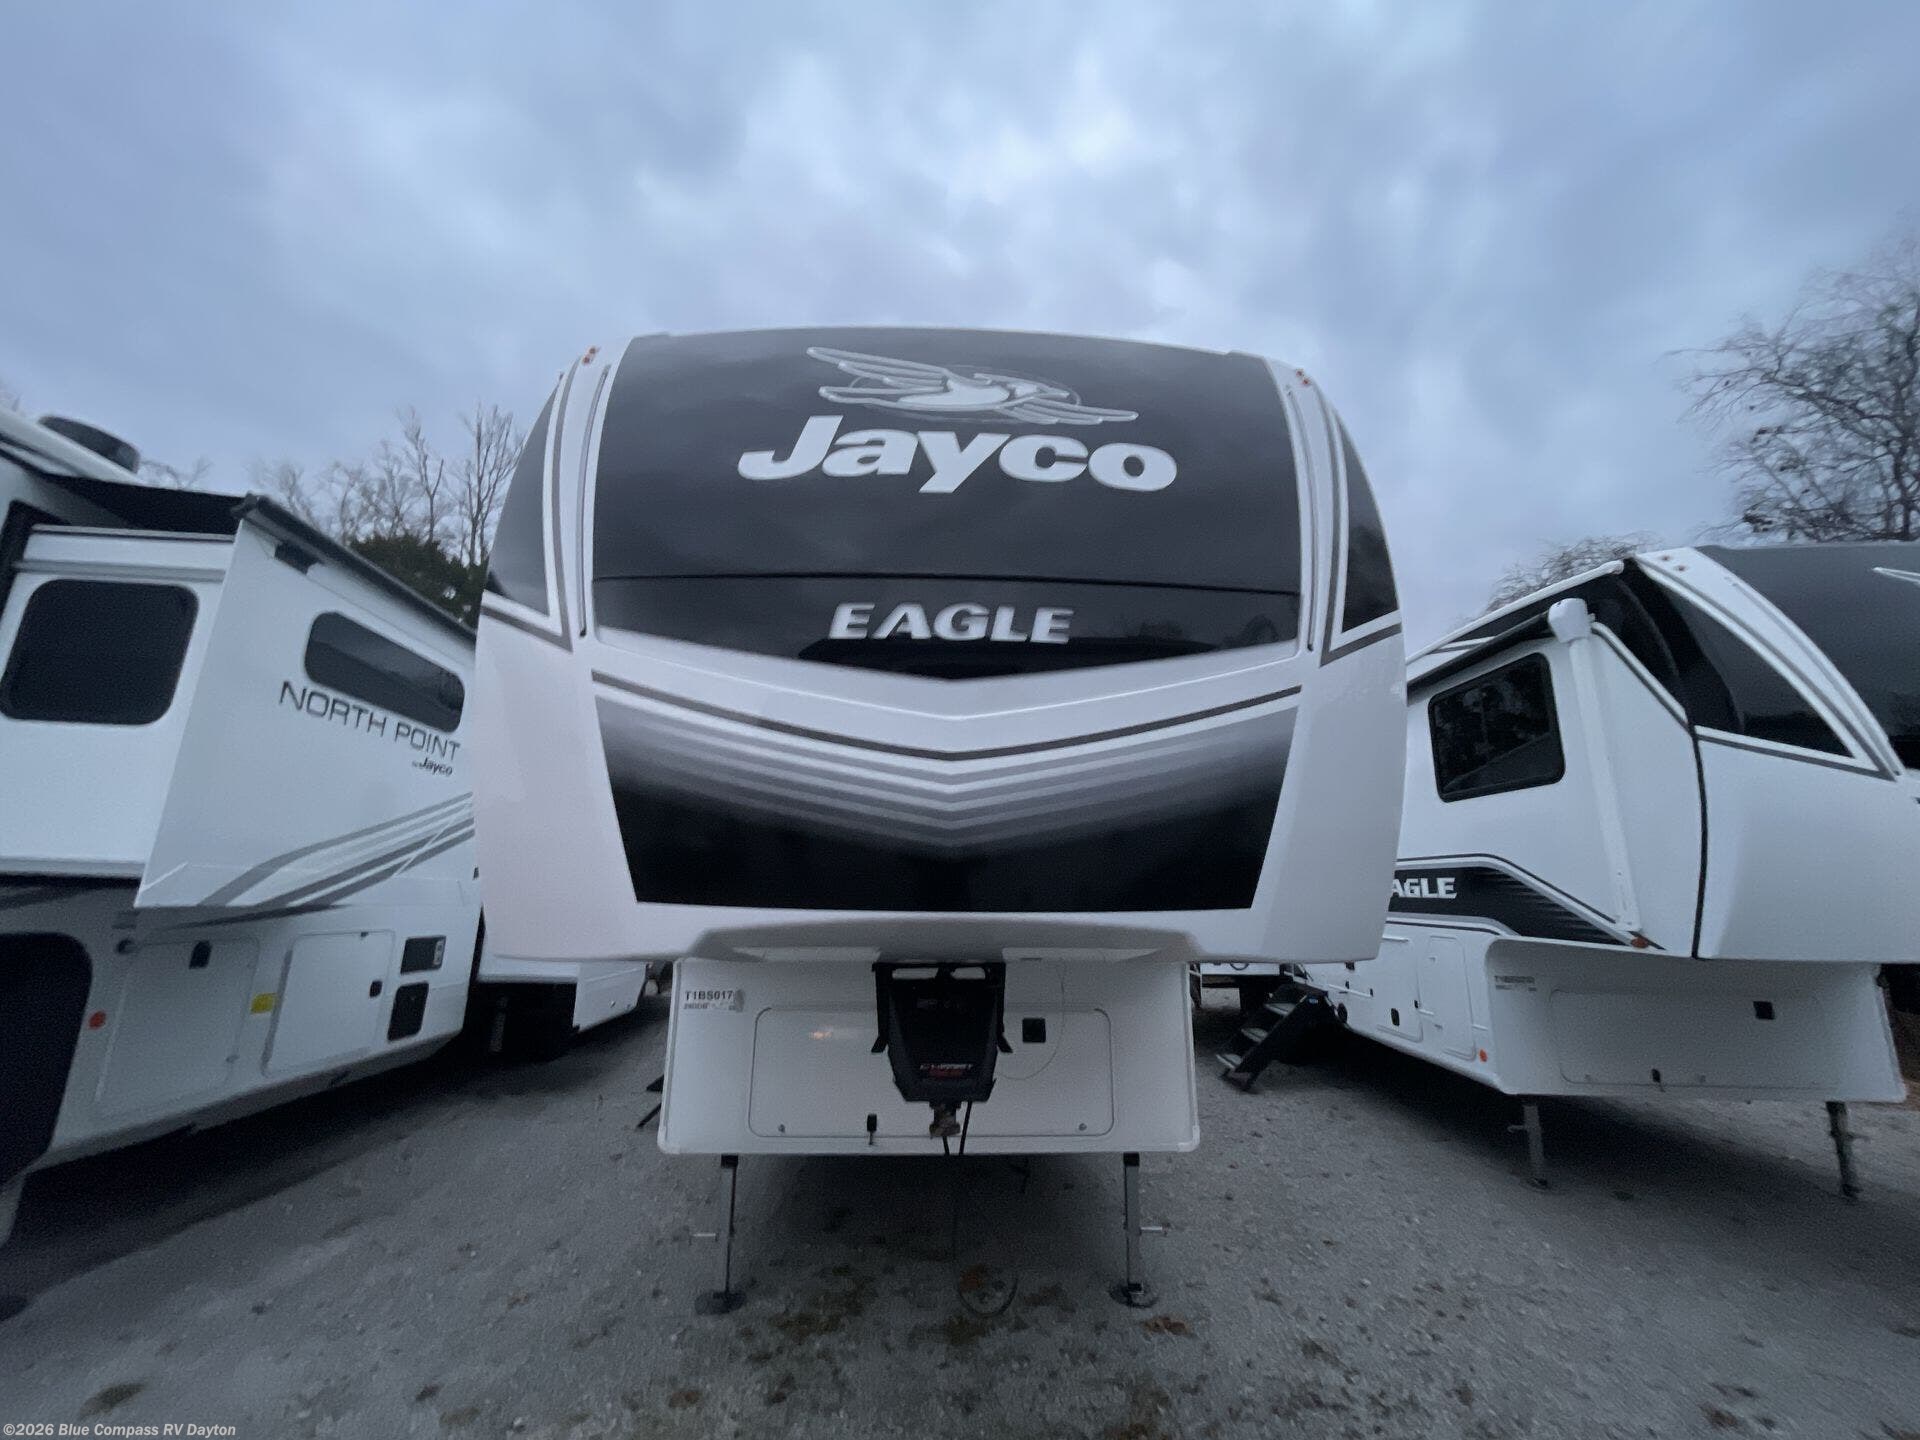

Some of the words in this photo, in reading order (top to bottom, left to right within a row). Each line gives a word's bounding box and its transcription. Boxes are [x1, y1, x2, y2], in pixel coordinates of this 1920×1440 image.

[737, 415, 1178, 494] Jayco
[828, 602, 1075, 644] EAGLE
[278, 680, 388, 738] NORTH
[394, 721, 461, 761] POINT
[419, 757, 453, 777] Jayco
[1392, 877, 1458, 899] AGLE
